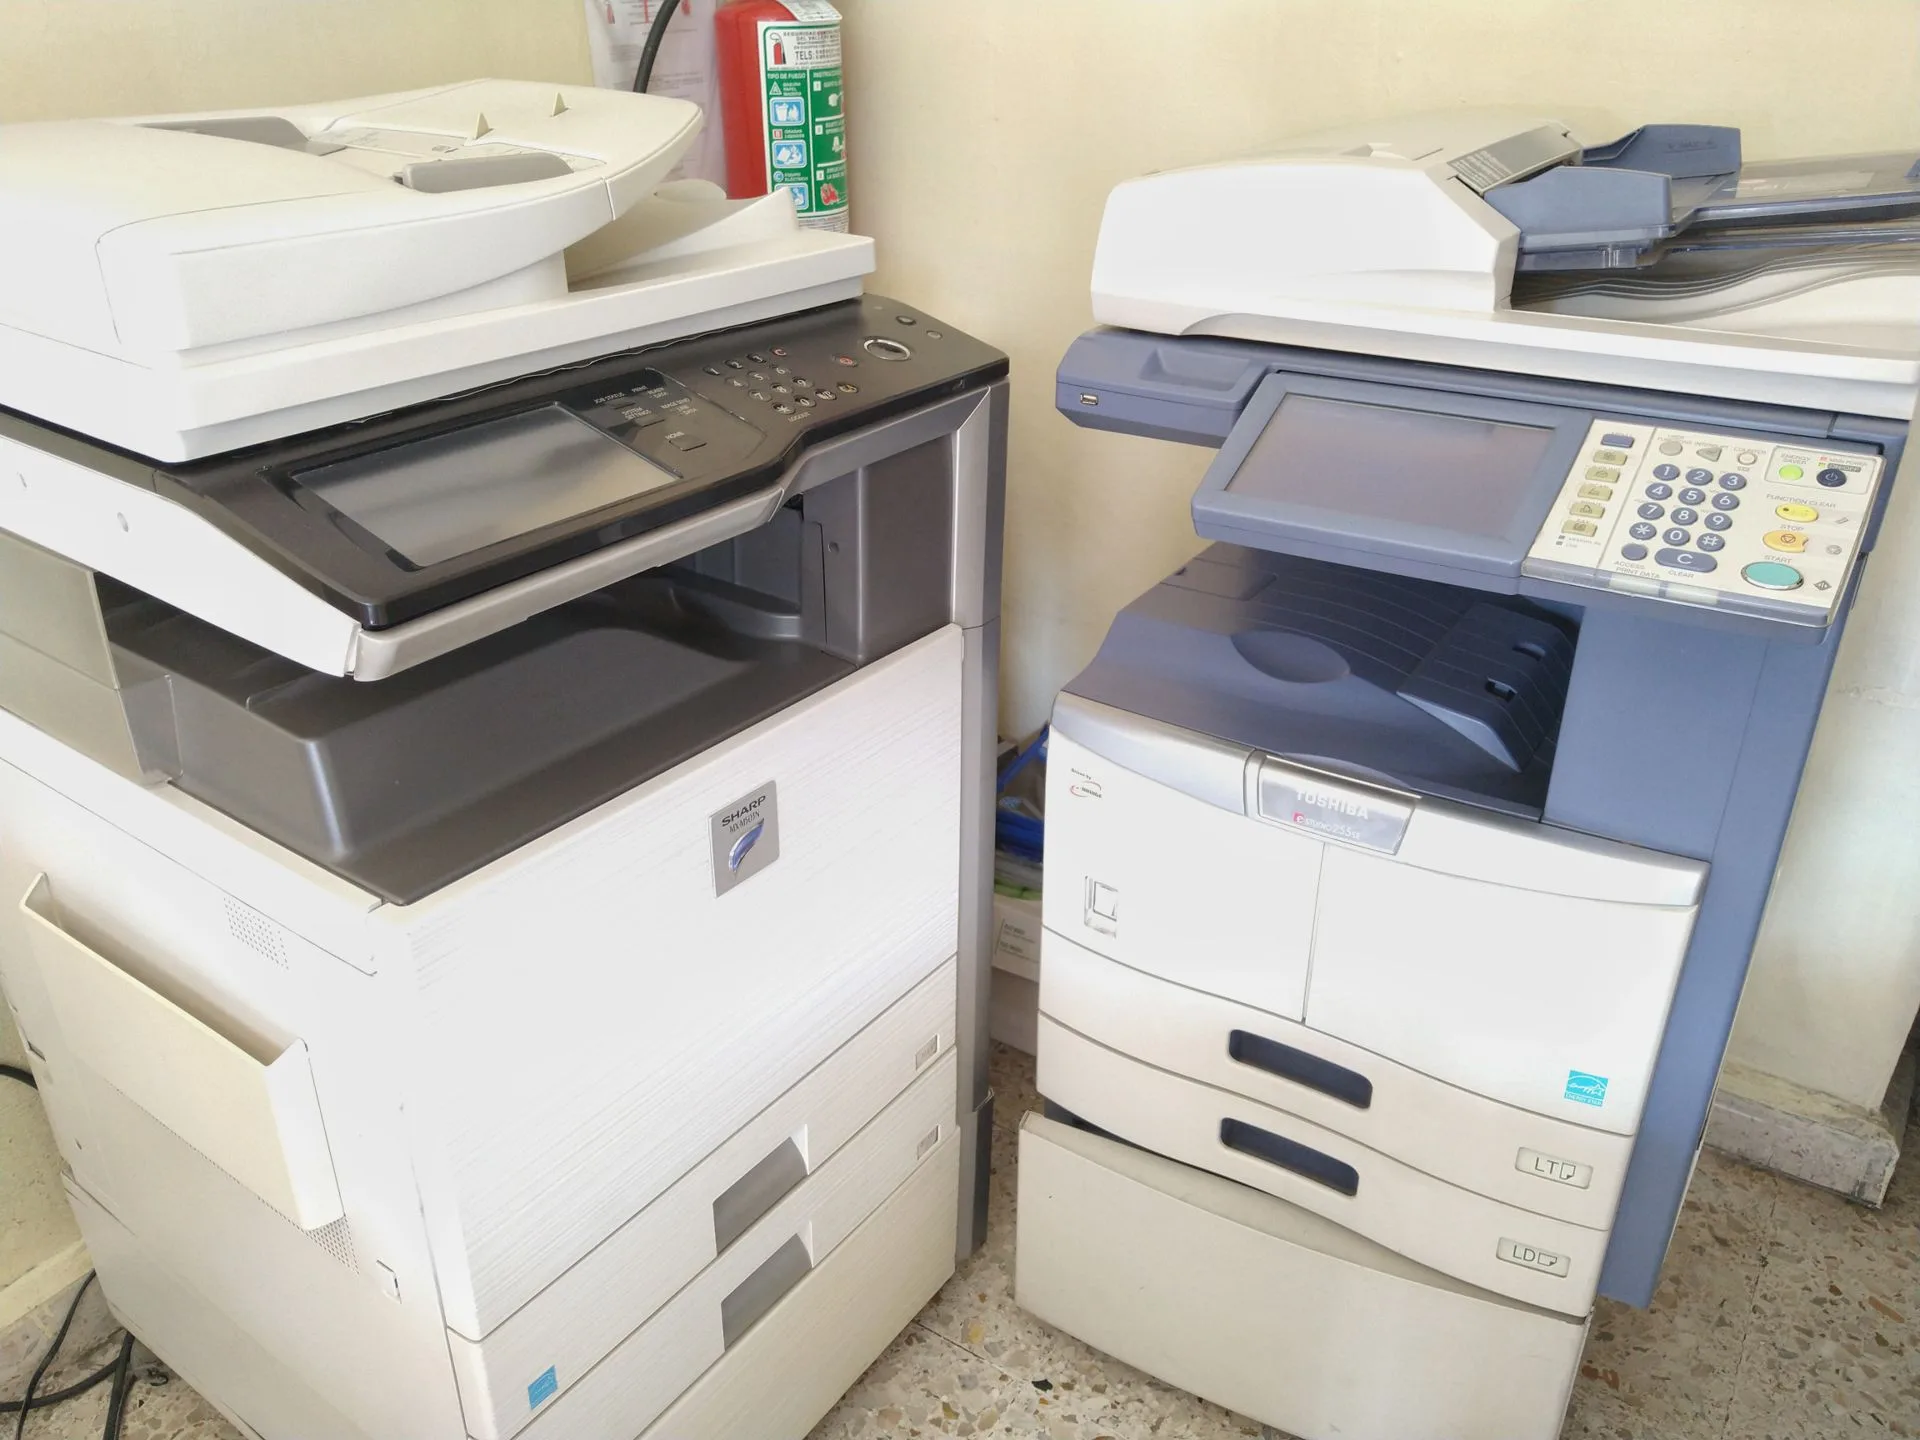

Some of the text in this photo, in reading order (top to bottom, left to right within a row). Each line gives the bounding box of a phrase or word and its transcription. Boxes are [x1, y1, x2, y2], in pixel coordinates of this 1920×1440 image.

[1663, 466, 1738, 486] 1 2 3
[1651, 485, 1731, 505] 4 5 6
[1766, 493, 1836, 509] FUNCTION CLEAR
[1647, 505, 1725, 526] 7 8 9
[1669, 530, 1682, 541] 0
[1779, 523, 1804, 532] STOP
[1614, 560, 1646, 570] ACCESS
[1676, 553, 1693, 565] C
[1764, 554, 1793, 564] START
[1615, 567, 1661, 579] PRINT DATA
[1667, 569, 1696, 579] CLEAR
[722, 795, 766, 827] SHARP
[1296, 790, 1369, 820] TOSHIBA
[1534, 1156, 1560, 1175] LT
[1512, 1244, 1536, 1262] LD
